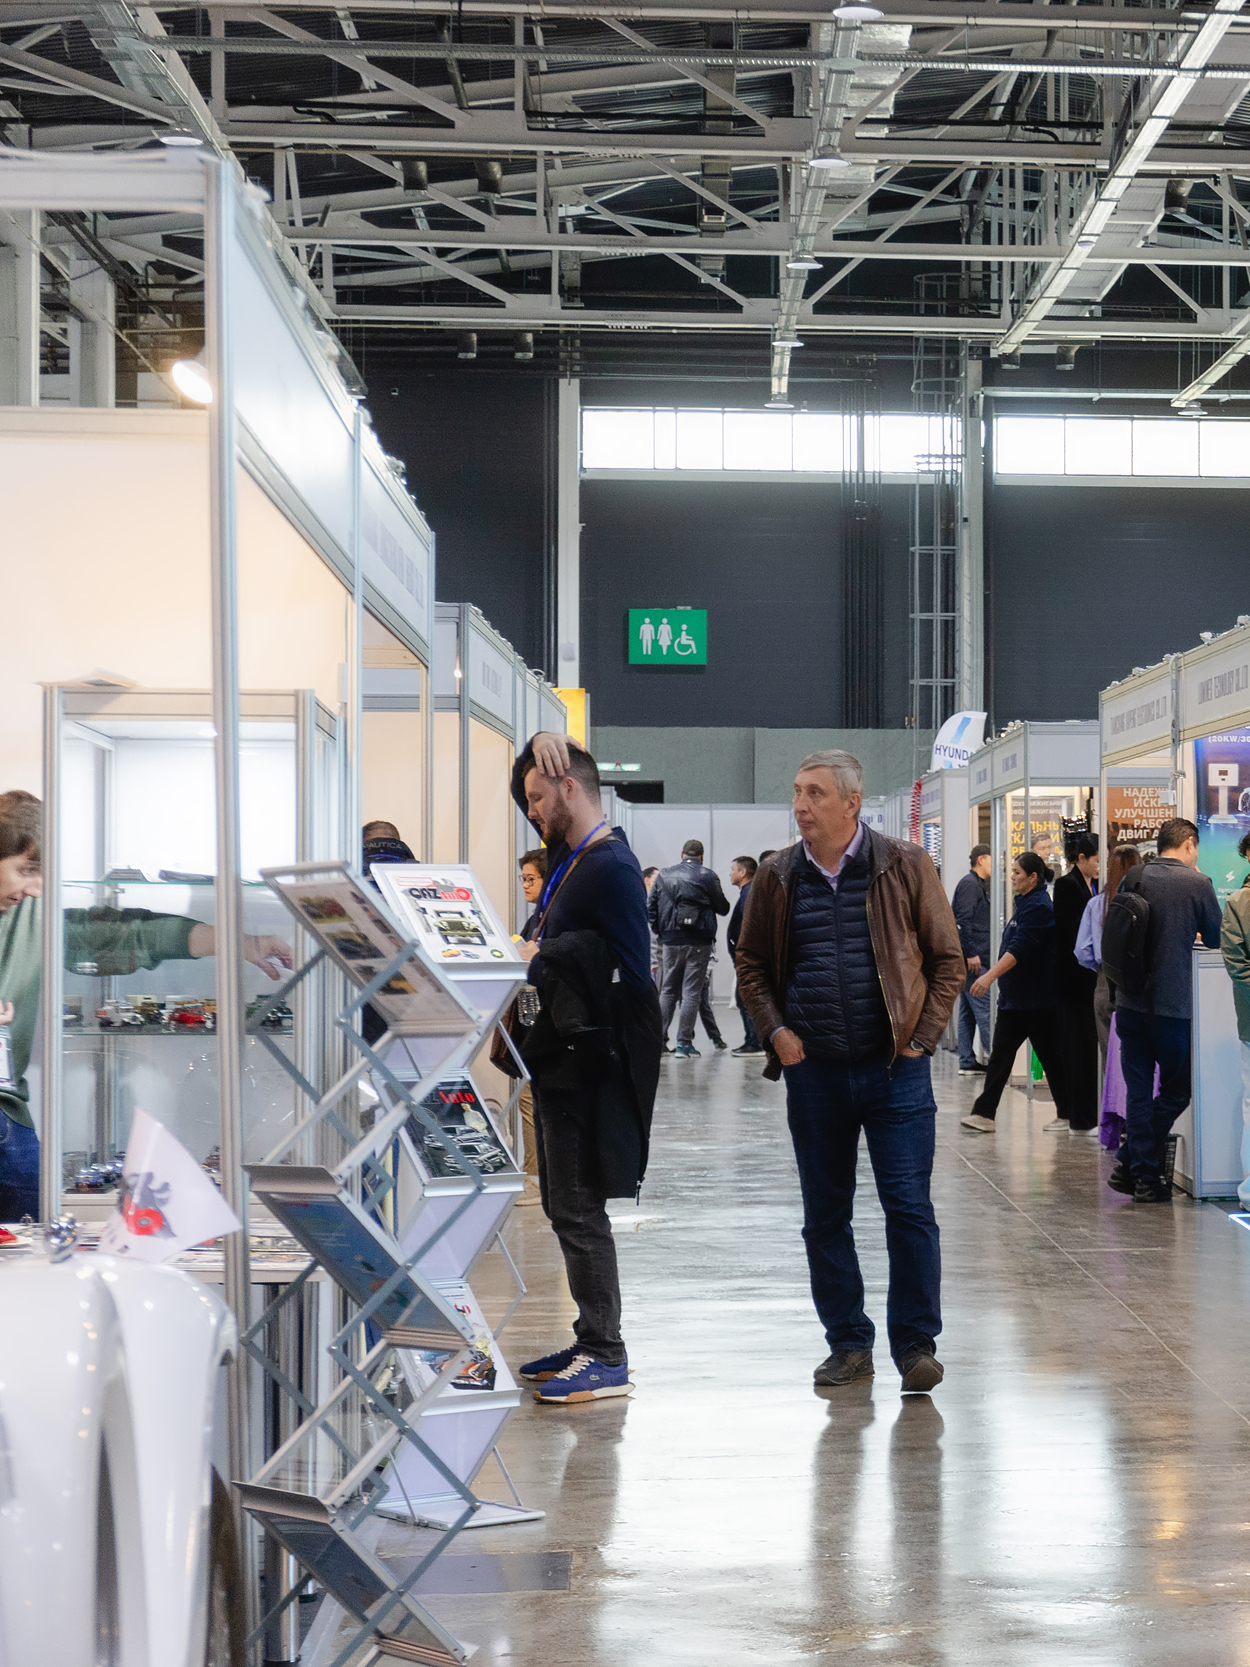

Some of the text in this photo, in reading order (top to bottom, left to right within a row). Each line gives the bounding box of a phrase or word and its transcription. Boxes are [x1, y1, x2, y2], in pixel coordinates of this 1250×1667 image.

[1123, 787, 1166, 798] НАДЕЖ
[1133, 798, 1161, 808] ИСК
[1114, 808, 1173, 818] УЛУЧШЕН
